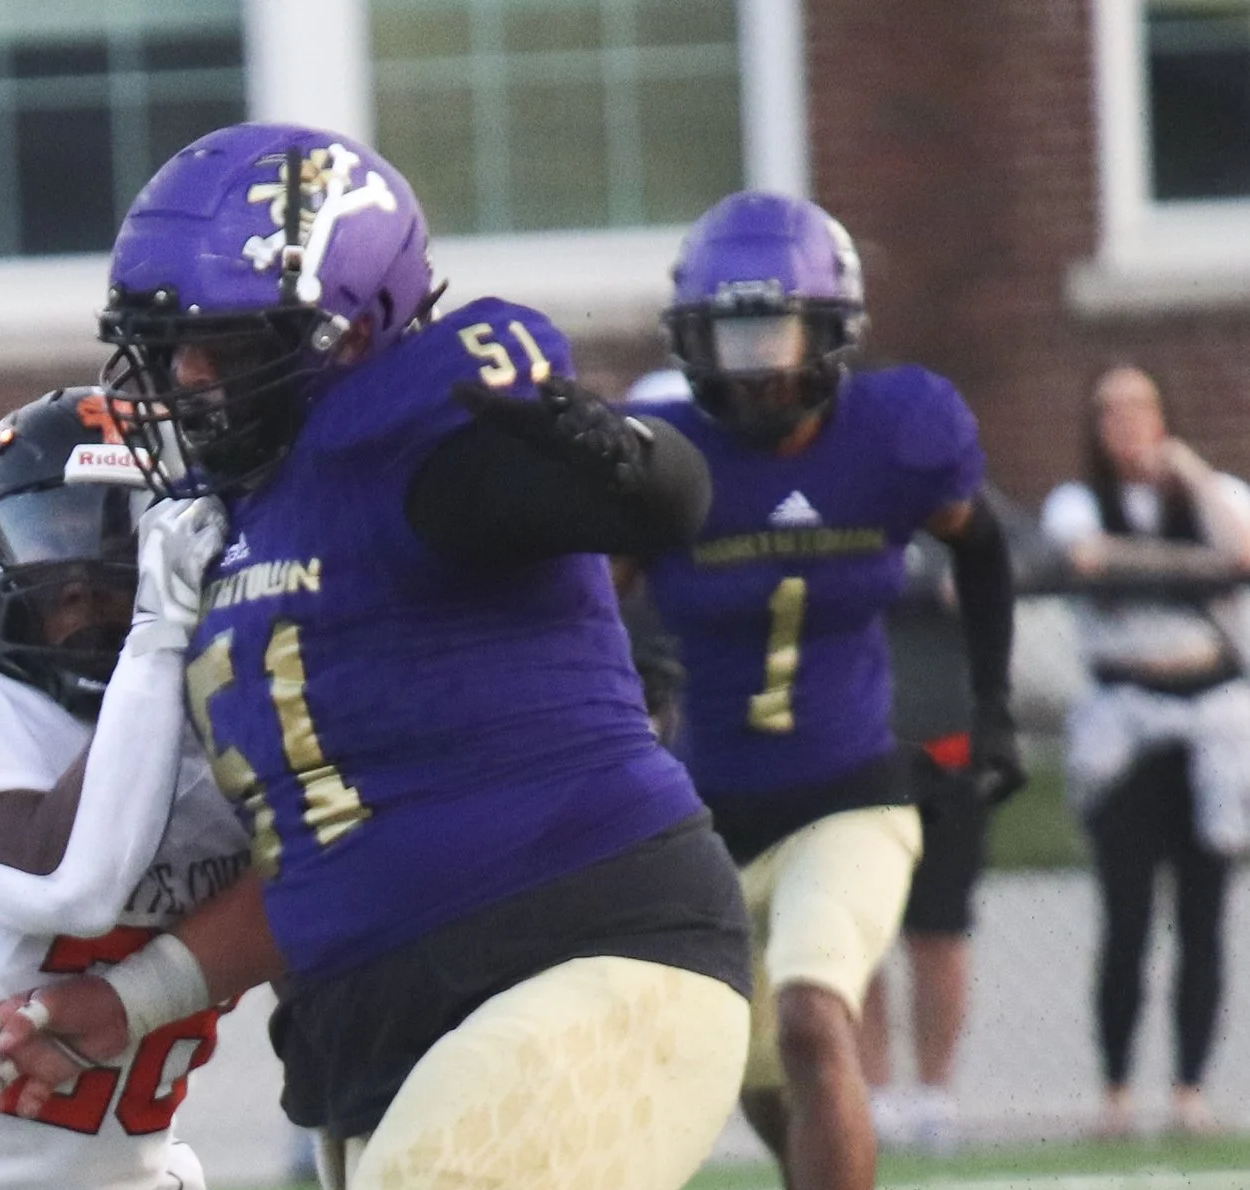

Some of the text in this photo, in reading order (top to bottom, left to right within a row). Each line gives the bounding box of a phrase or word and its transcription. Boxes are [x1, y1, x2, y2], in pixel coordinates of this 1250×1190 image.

[457, 320, 551, 387] 51
[79, 451, 153, 469] Ridd
[748, 577, 806, 733] 1
[186, 618, 373, 879] 51
